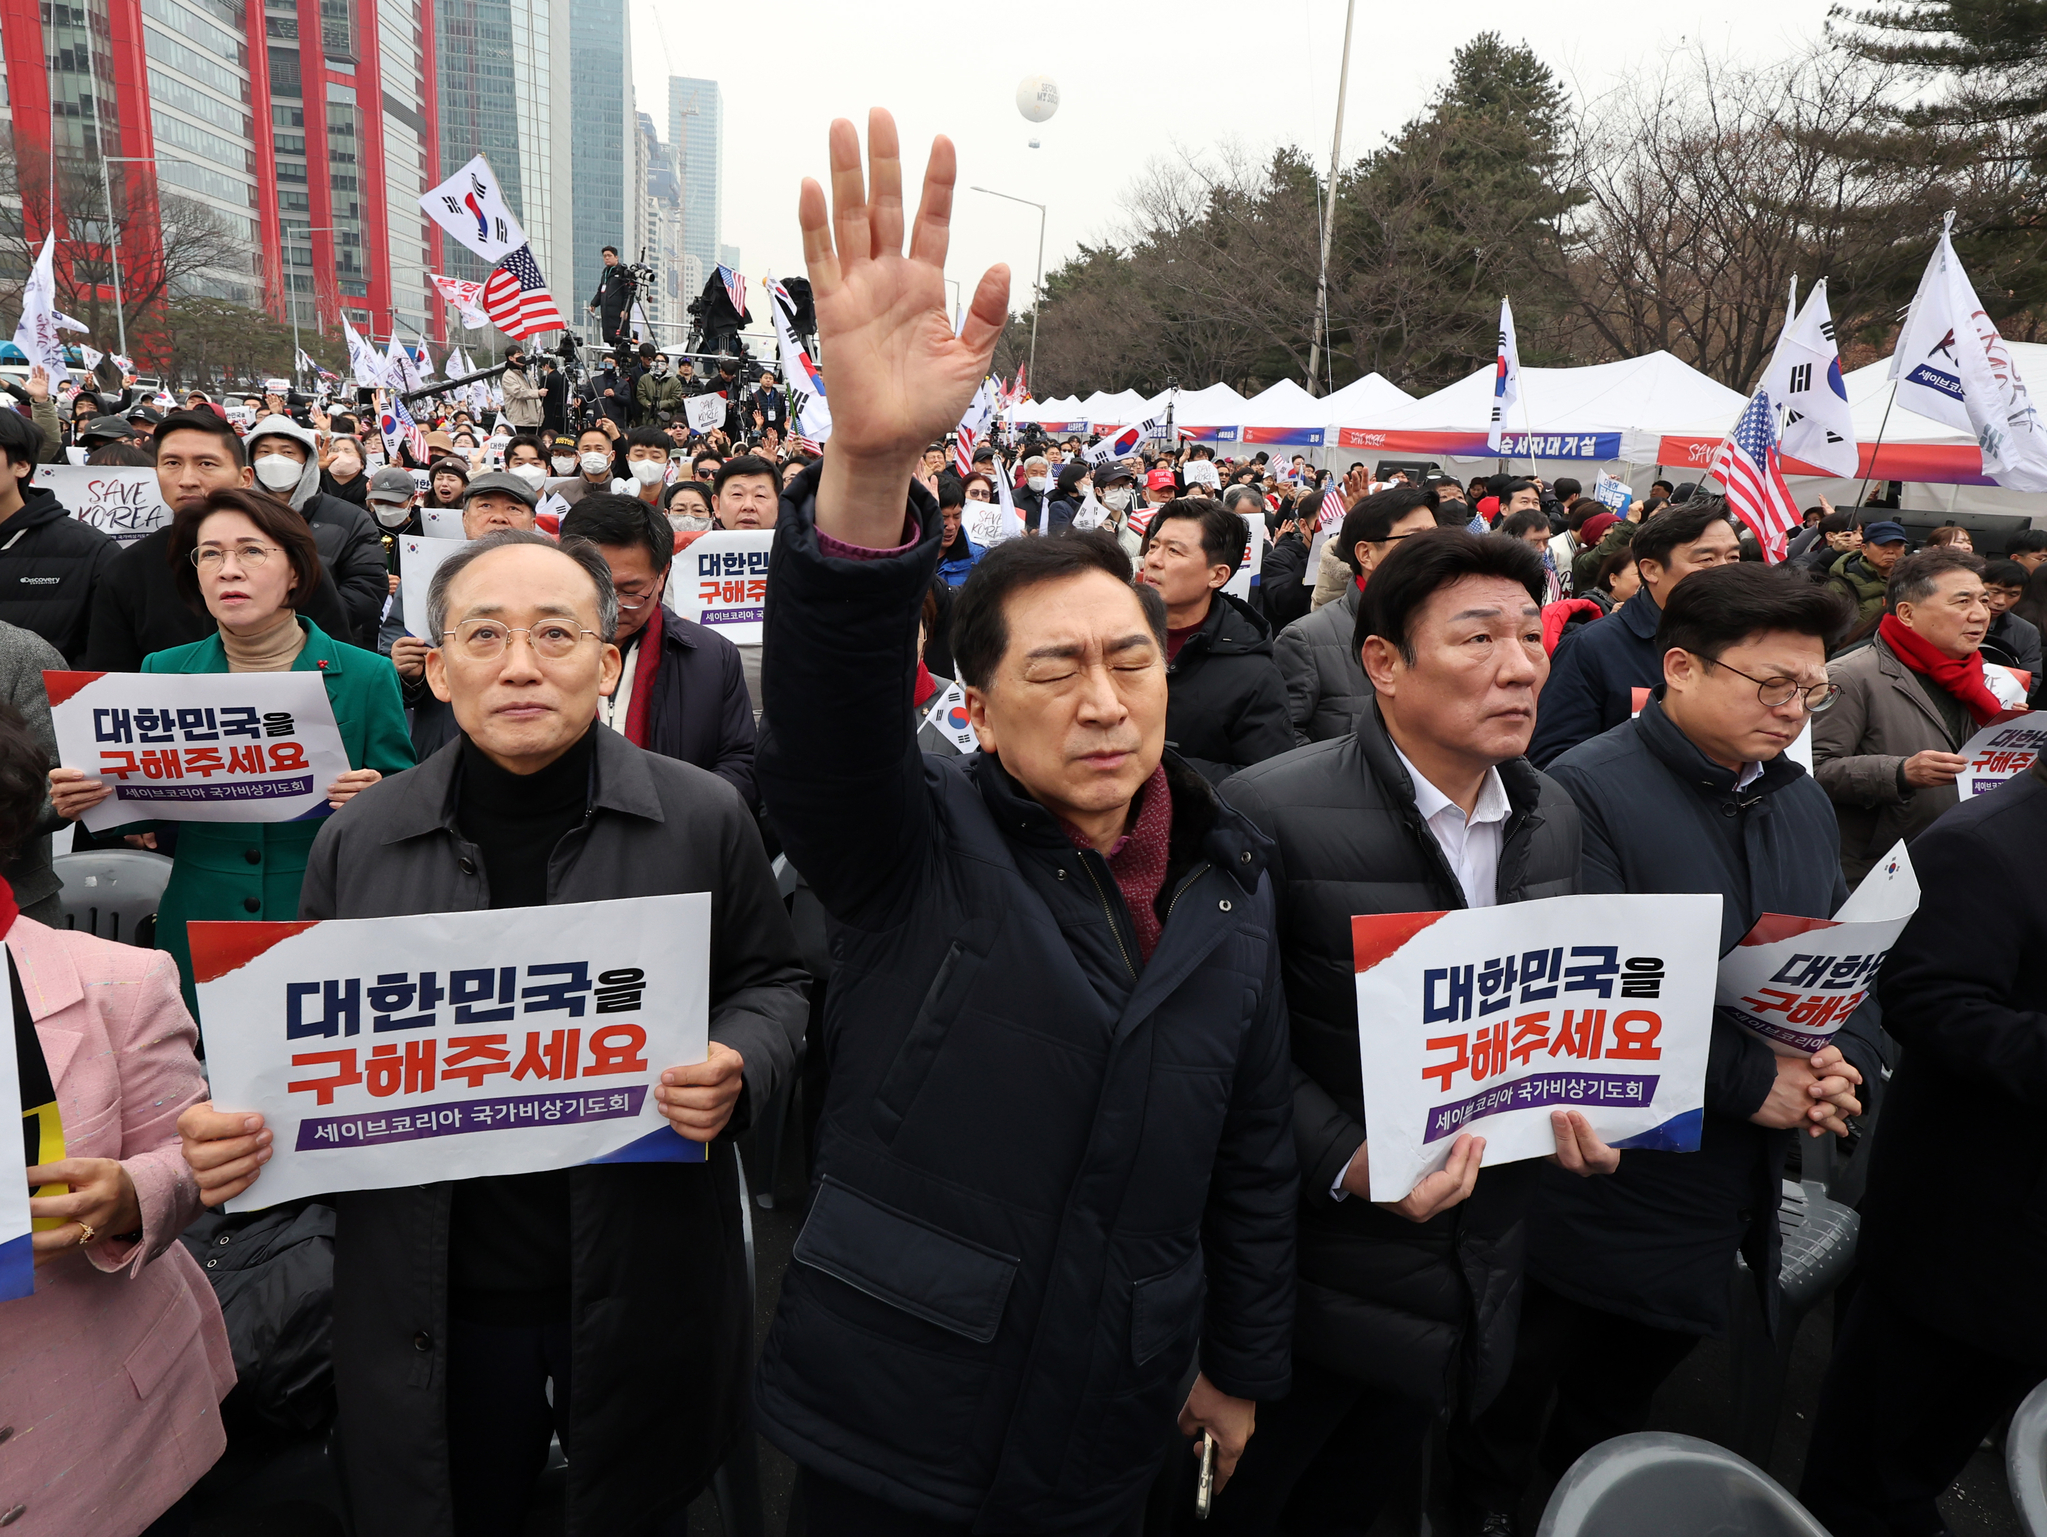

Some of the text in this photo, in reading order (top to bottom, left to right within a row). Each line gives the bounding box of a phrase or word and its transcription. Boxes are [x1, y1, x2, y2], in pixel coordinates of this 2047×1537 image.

[1500, 436, 1597, 457] 순서자대기실
[87, 479, 150, 505] SAVE
[78, 504, 164, 530] KOREA
[705, 610, 745, 622] 세이브코리아
[92, 706, 295, 744] 대한민국을
[99, 741, 310, 780] 구해주세요
[1971, 751, 2039, 774] 구해주
[125, 781, 306, 799] 세이브코리아 국가비상기도회
[286, 960, 647, 1041] 대한민국을
[1422, 945, 1666, 1026] 대한민국을
[1731, 1009, 1826, 1050] 세이브코리아
[287, 1023, 649, 1106] 구해주세요
[1421, 1008, 1663, 1093] 구해주세요
[313, 1092, 630, 1144] 세이브코리아 국가비상기도회
[1435, 1078, 1644, 1131] 세이브코리아 국가비상기도회
